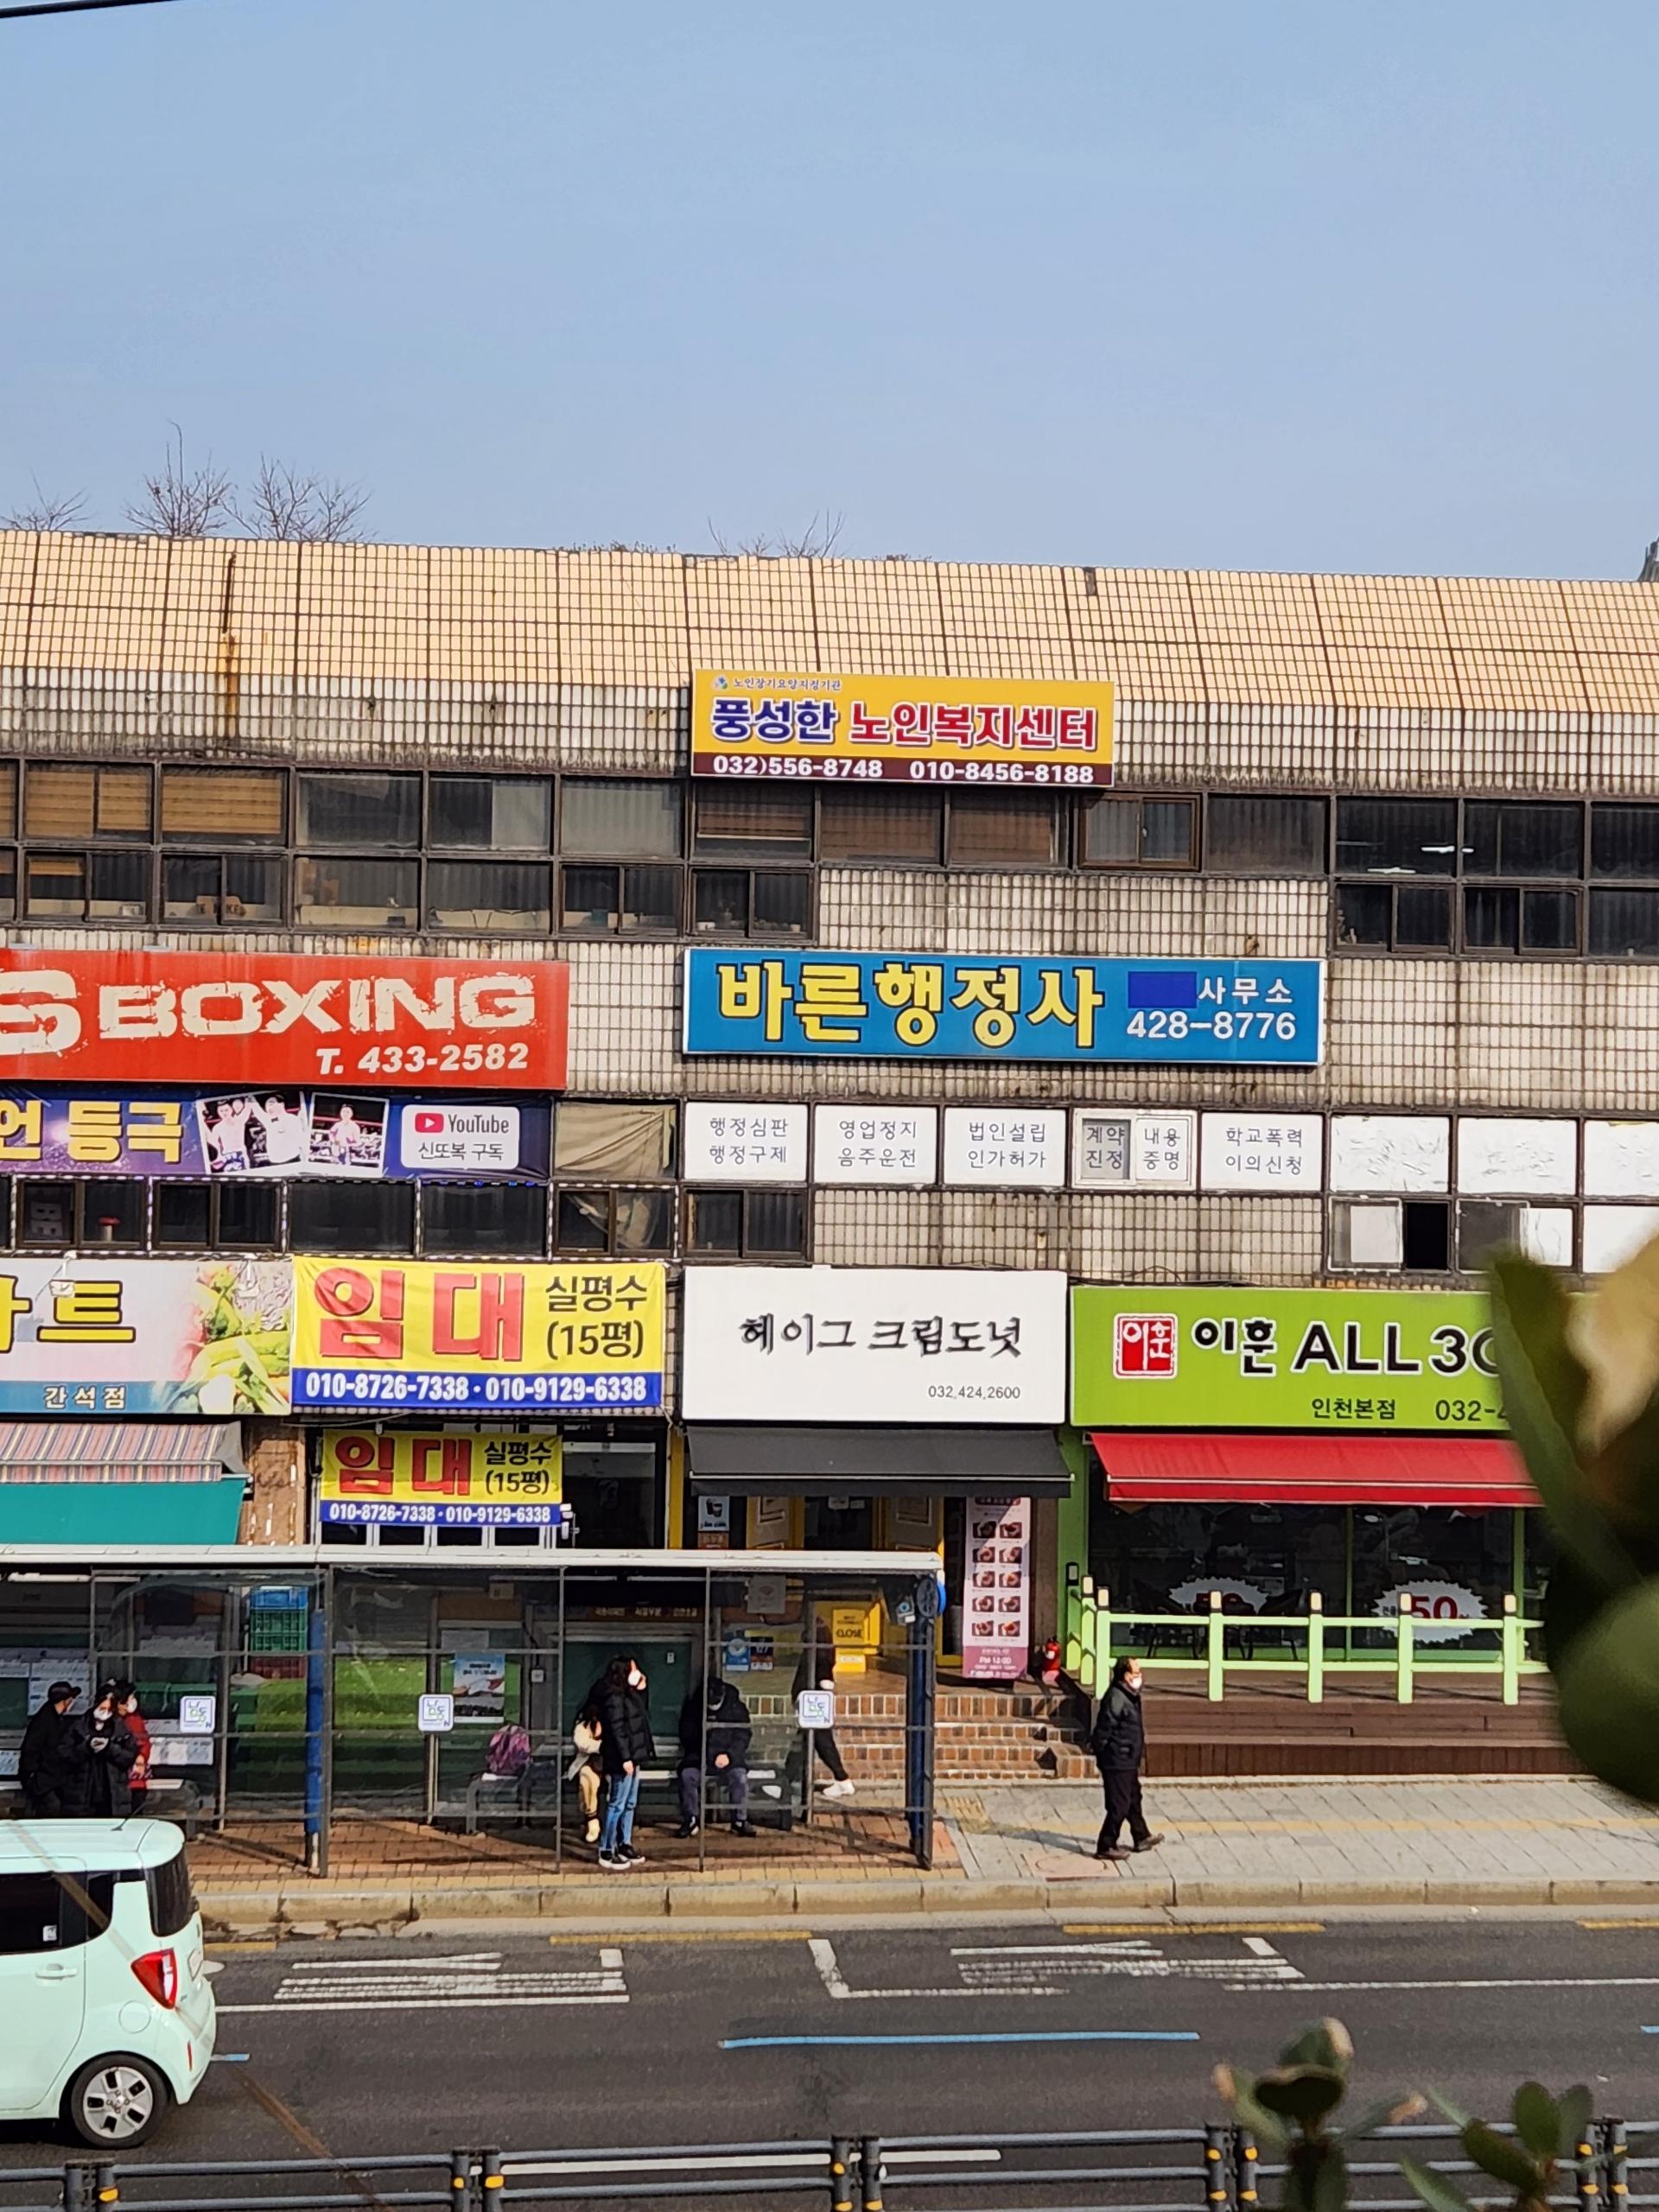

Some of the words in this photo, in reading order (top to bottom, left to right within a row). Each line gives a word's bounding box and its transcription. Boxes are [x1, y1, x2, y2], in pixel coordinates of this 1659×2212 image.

[733, 677, 842, 692] 노인장기요양지정기관
[710, 696, 837, 743] 풍성한
[849, 700, 1097, 753] 노인복지센터
[712, 754, 884, 779] 032)556-8748
[910, 760, 1095, 784] 010-8456-8188
[1198, 976, 1294, 1006] 사무소
[0, 969, 82, 1056] S
[99, 975, 537, 1039] BOXING
[715, 960, 1105, 1049] 바른행정사
[1126, 1010, 1297, 1041] 428-8776
[358, 1042, 529, 1075] 433-2582
[67, 1100, 184, 1164] 등극
[447, 1114, 510, 1135] YouTube
[709, 1116, 789, 1139] 행정심판
[838, 1119, 918, 1141] 영업정지
[968, 1122, 1046, 1143] 법인설립
[1086, 1125, 1125, 1147] 계약
[1225, 1127, 1303, 1147] 학교폭력
[1143, 1127, 1181, 1148] 내용
[418, 1141, 467, 1161] 신또복
[472, 1141, 504, 1162] 구독
[709, 1145, 788, 1166] 행정구제
[837, 1147, 918, 1168] 음주운전
[967, 1150, 1047, 1170] 인가허가
[1084, 1149, 1124, 1171] 진정
[1142, 1151, 1180, 1172] 증명
[1224, 1154, 1303, 1176] 이의신청
[544, 1274, 648, 1313] 실평수
[0, 1274, 136, 1354] 트
[313, 1266, 525, 1361] 임대
[546, 1319, 645, 1360] (15평)
[739, 1313, 857, 1356] 헤이그
[867, 1315, 1022, 1358] 크림도넛
[1193, 1319, 1275, 1376] 이훈
[1293, 1322, 1420, 1373] ALL
[45, 1385, 127, 1410] 간석점
[306, 1372, 469, 1401] 010-8726-7338
[486, 1374, 647, 1402] 010-9129-6338
[1311, 1397, 1397, 1421] 인천본점
[334, 1435, 473, 1496] 임대
[484, 1440, 552, 1466] 실평수
[485, 1470, 550, 1495] (15평)
[329, 1502, 435, 1522] 010-8726-7338
[446, 1505, 551, 1523] 010-9129-6338
